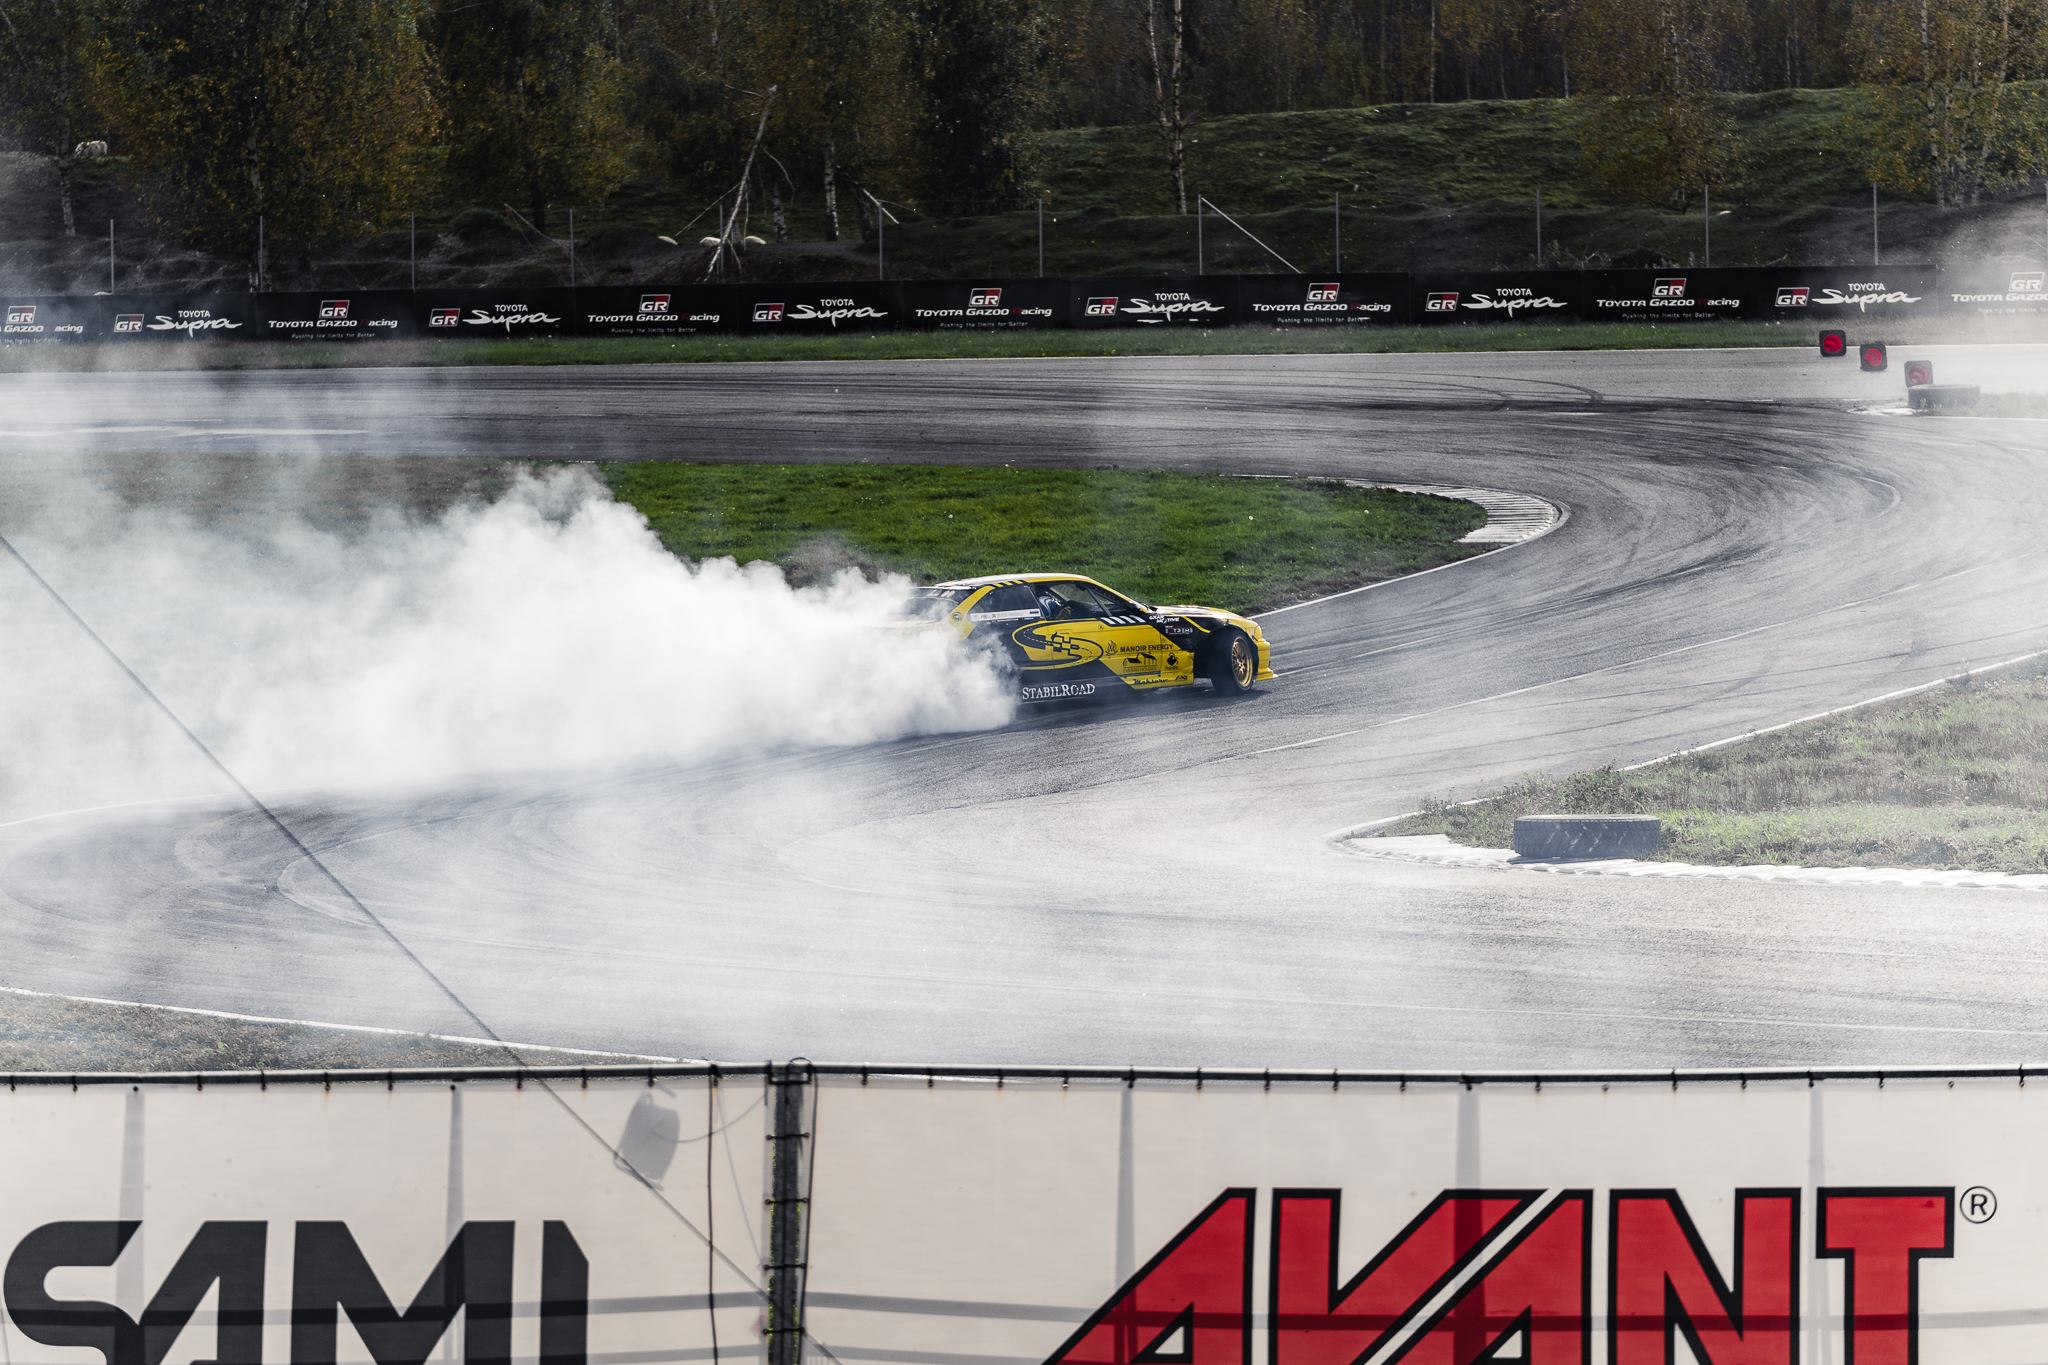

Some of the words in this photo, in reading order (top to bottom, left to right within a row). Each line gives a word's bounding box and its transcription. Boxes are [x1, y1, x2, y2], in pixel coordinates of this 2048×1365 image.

[1848, 282, 1885, 291] TOYOTA
[2010, 279, 2041, 290] GR
[1308, 290, 1337, 300] GR
[1496, 288, 1532, 296] TOYOTA
[1654, 285, 1683, 296] GR
[971, 295, 999, 305] GR
[1596, 299, 1646, 307] TOYOTA
[1649, 298, 1695, 307] GAZOO
[1697, 297, 1740, 308] Racing
[1777, 294, 1806, 305] GR
[1811, 288, 1922, 313] Supra
[1951, 293, 2003, 302] TOYOTA
[494, 304, 528, 312] TOYOTA
[641, 301, 668, 311] GR
[1087, 304, 1115, 314] GR
[1120, 298, 1225, 321] Supra
[1252, 303, 1300, 312] TOYOTA
[1303, 303, 1348, 311] GAZOO
[1427, 299, 1456, 310] GR
[1461, 293, 1567, 318] Supra
[8, 312, 33, 322] GR
[178, 310, 211, 318] TOYOTA
[321, 307, 347, 317] GR
[754, 310, 781, 320] GR
[786, 304, 888, 327] Supra
[915, 309, 963, 317] TOYOTA
[966, 308, 1010, 316] GAZOO
[1012, 307, 1052, 317] Racing
[431, 315, 458, 325] GR
[462, 309, 560, 332] Supra
[587, 314, 633, 322] TOYOTA
[636, 313, 678, 322] GAZOO
[681, 313, 720, 323] Racing
[3, 324, 44, 333] GAZOO
[115, 321, 142, 331] GR
[146, 315, 242, 338] Supra
[268, 320, 314, 328] TOYOTA
[316, 319, 358, 327] GAZOO
[1120, 644, 1147, 652] MANOIR
[1148, 643, 1174, 651] ENERGY
[1022, 683, 1096, 700] STABILROAD
[1042, 1187, 1955, 1365] AVANT
[3, 1220, 589, 1365] SAMI
